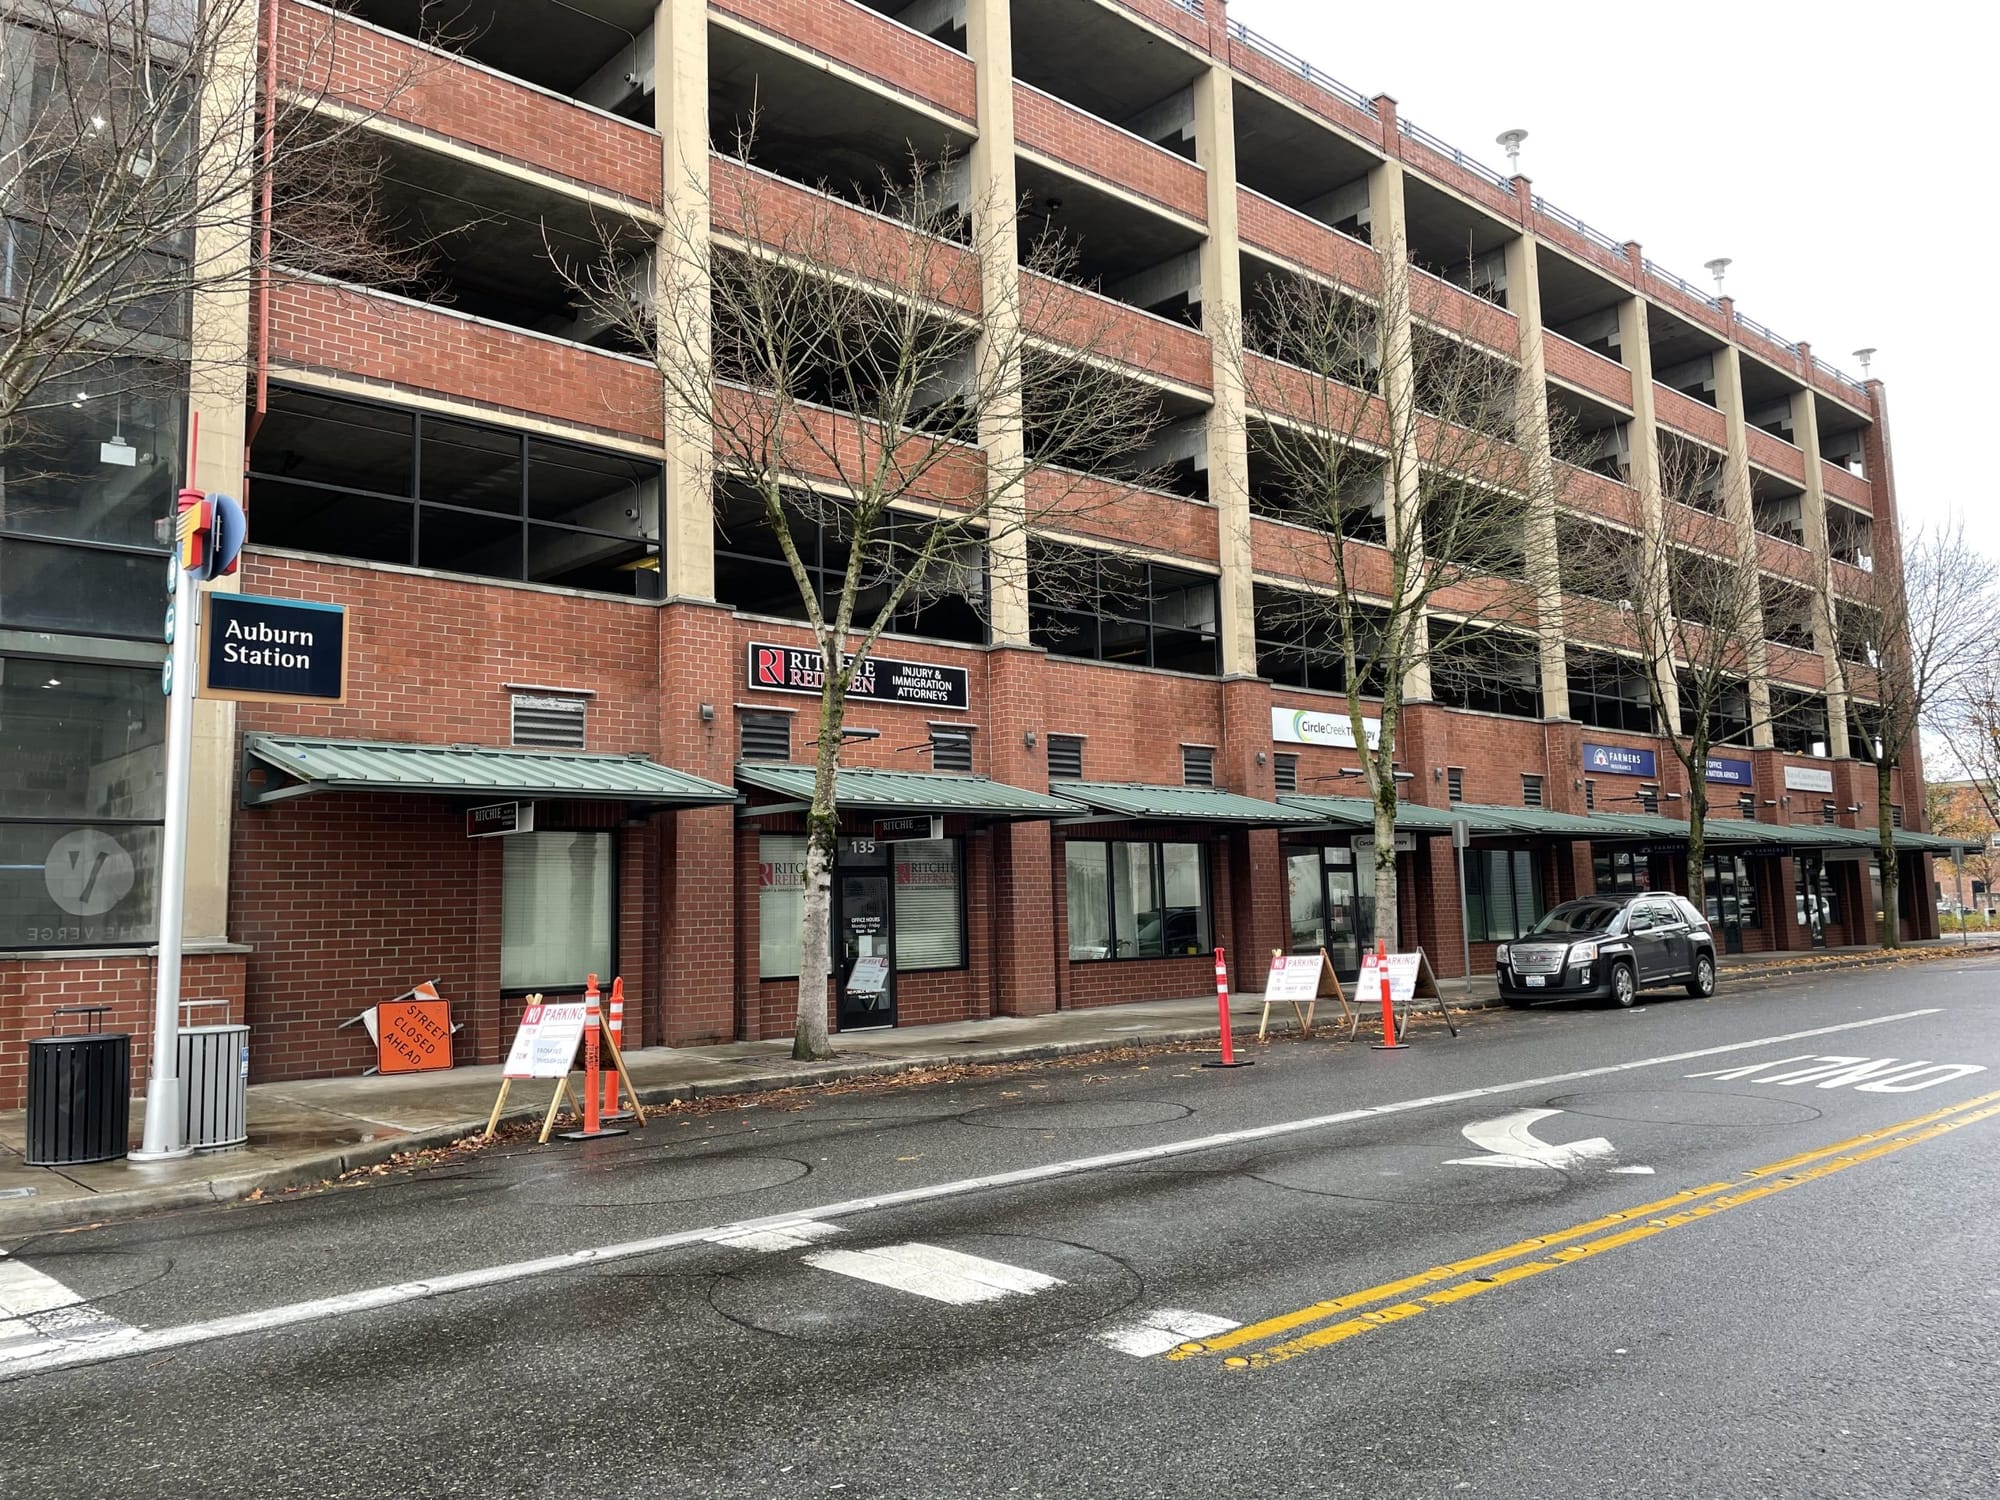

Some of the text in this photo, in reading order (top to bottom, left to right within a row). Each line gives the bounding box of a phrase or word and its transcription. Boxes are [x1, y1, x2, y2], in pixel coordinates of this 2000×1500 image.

[225, 619, 313, 646] Auburn
[223, 643, 310, 670] Station
[902, 666, 942, 680] INJURY &
[892, 675, 952, 691] IMMIGRATION
[897, 687, 948, 701] ATTORNEYS
[1609, 752, 1641, 764] FARMERS
[1708, 760, 1722, 769] OFFICE
[475, 807, 502, 822] RITCHIE
[883, 819, 914, 831] RITCHIE
[851, 840, 875, 854] 135
[775, 862, 805, 874] RITC
[1274, 957, 1319, 969] NO PARKING
[1366, 956, 1416, 967] NO ARKING
[407, 1005, 448, 1040] STREET
[525, 1007, 585, 1024] NO PARKING
[394, 1016, 436, 1054] CLOSED
[383, 1032, 421, 1065] AHEAD
[1682, 1055, 1988, 1093] ONLY
